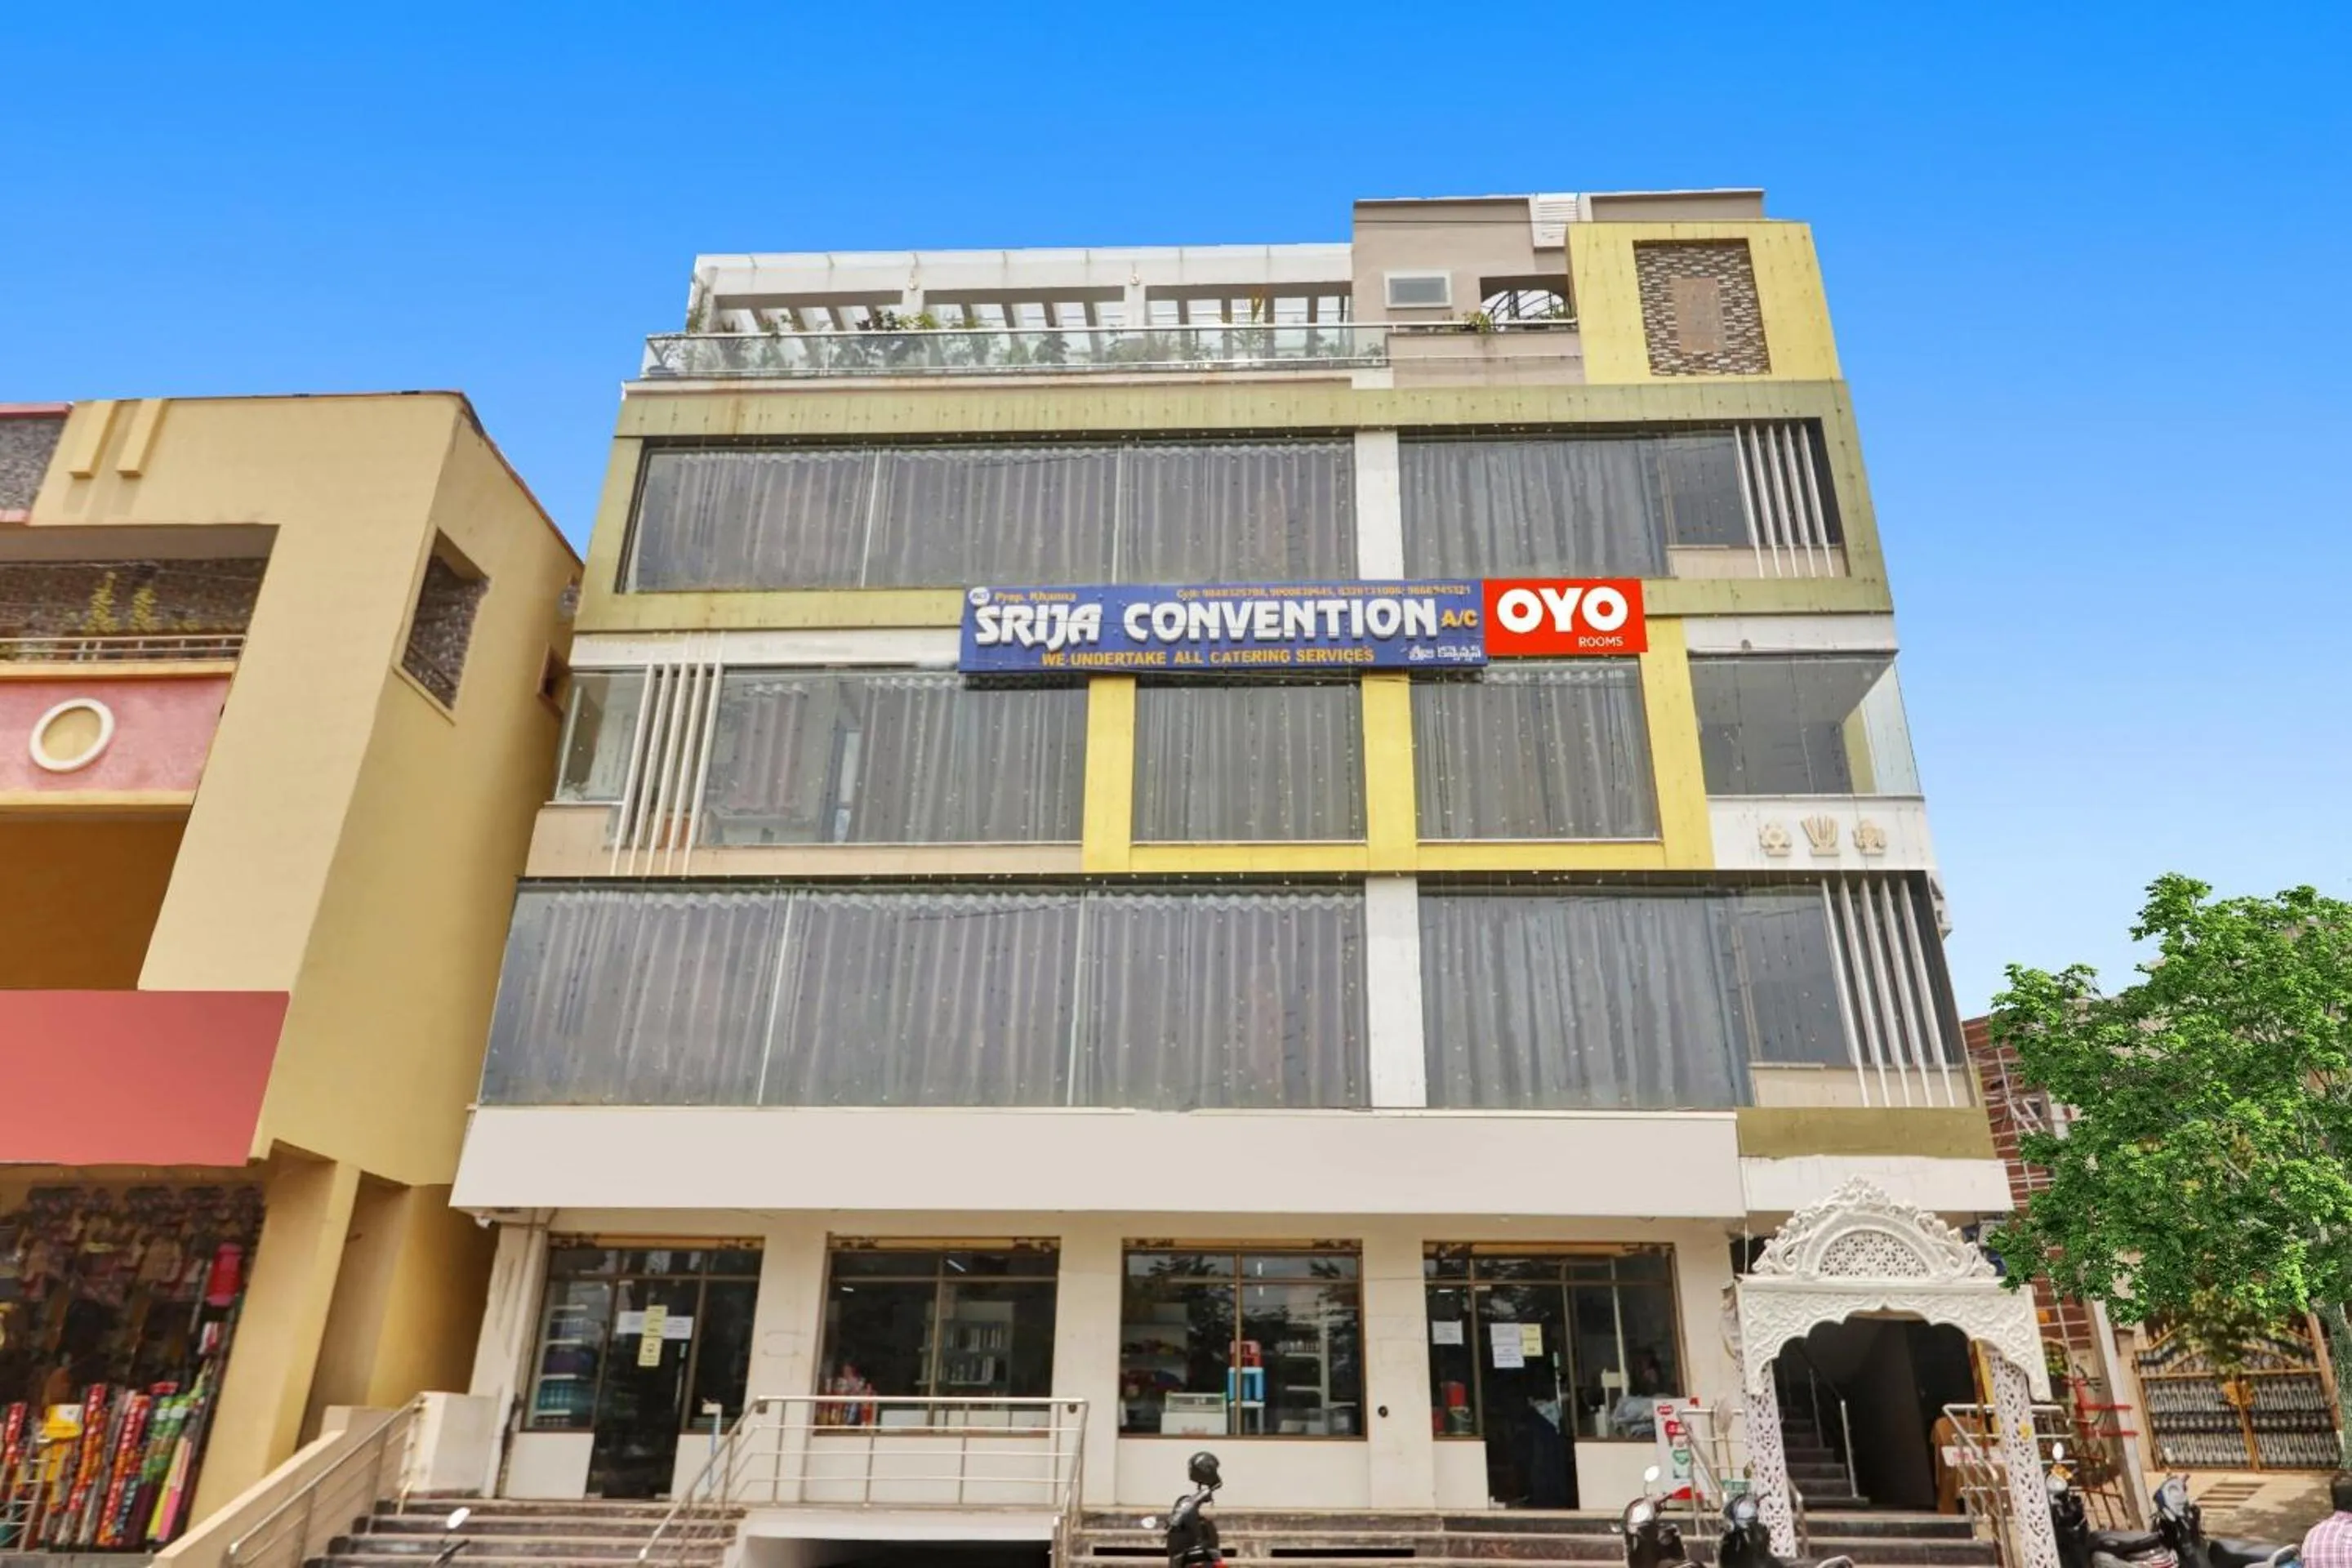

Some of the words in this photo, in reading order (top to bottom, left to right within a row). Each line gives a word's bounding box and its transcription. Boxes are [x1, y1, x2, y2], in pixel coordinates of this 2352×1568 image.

[1441, 609, 1478, 629] A/C
[1496, 586, 1628, 634] OYO
[975, 602, 1102, 652] SRIJA
[1124, 598, 1438, 643] CONVENTION
[1579, 636, 1624, 648] ROOMS
[1042, 653, 1067, 666] WE
[1071, 652, 1166, 666] UNDERTAKE
[1174, 651, 1203, 665] ALL
[1209, 649, 1291, 664] CATERING
[1296, 648, 1374, 663] SERVICES
